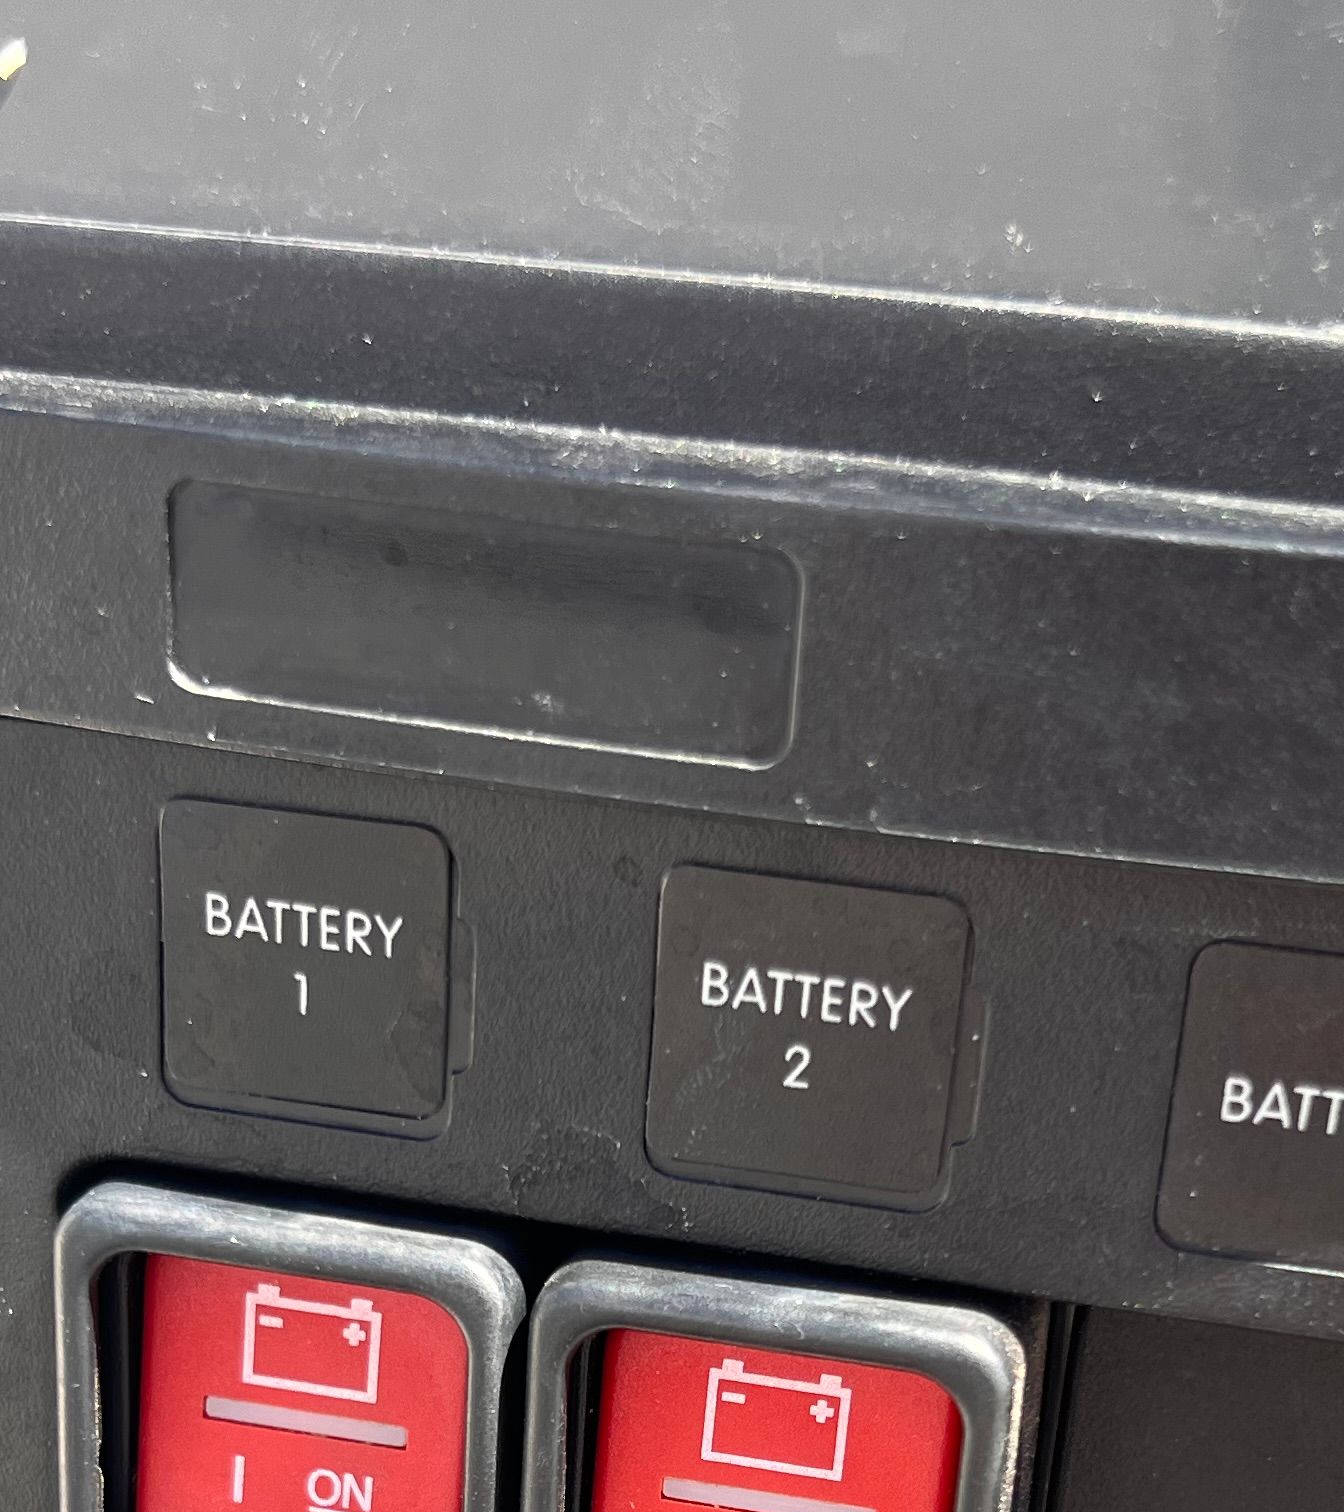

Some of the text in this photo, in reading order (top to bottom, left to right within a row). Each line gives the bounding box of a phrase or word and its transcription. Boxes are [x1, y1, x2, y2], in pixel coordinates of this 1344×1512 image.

[204, 889, 403, 960] BATTERY
[293, 970, 308, 1017] 1
[701, 959, 913, 1033] BATTERY
[782, 1042, 812, 1090] 2
